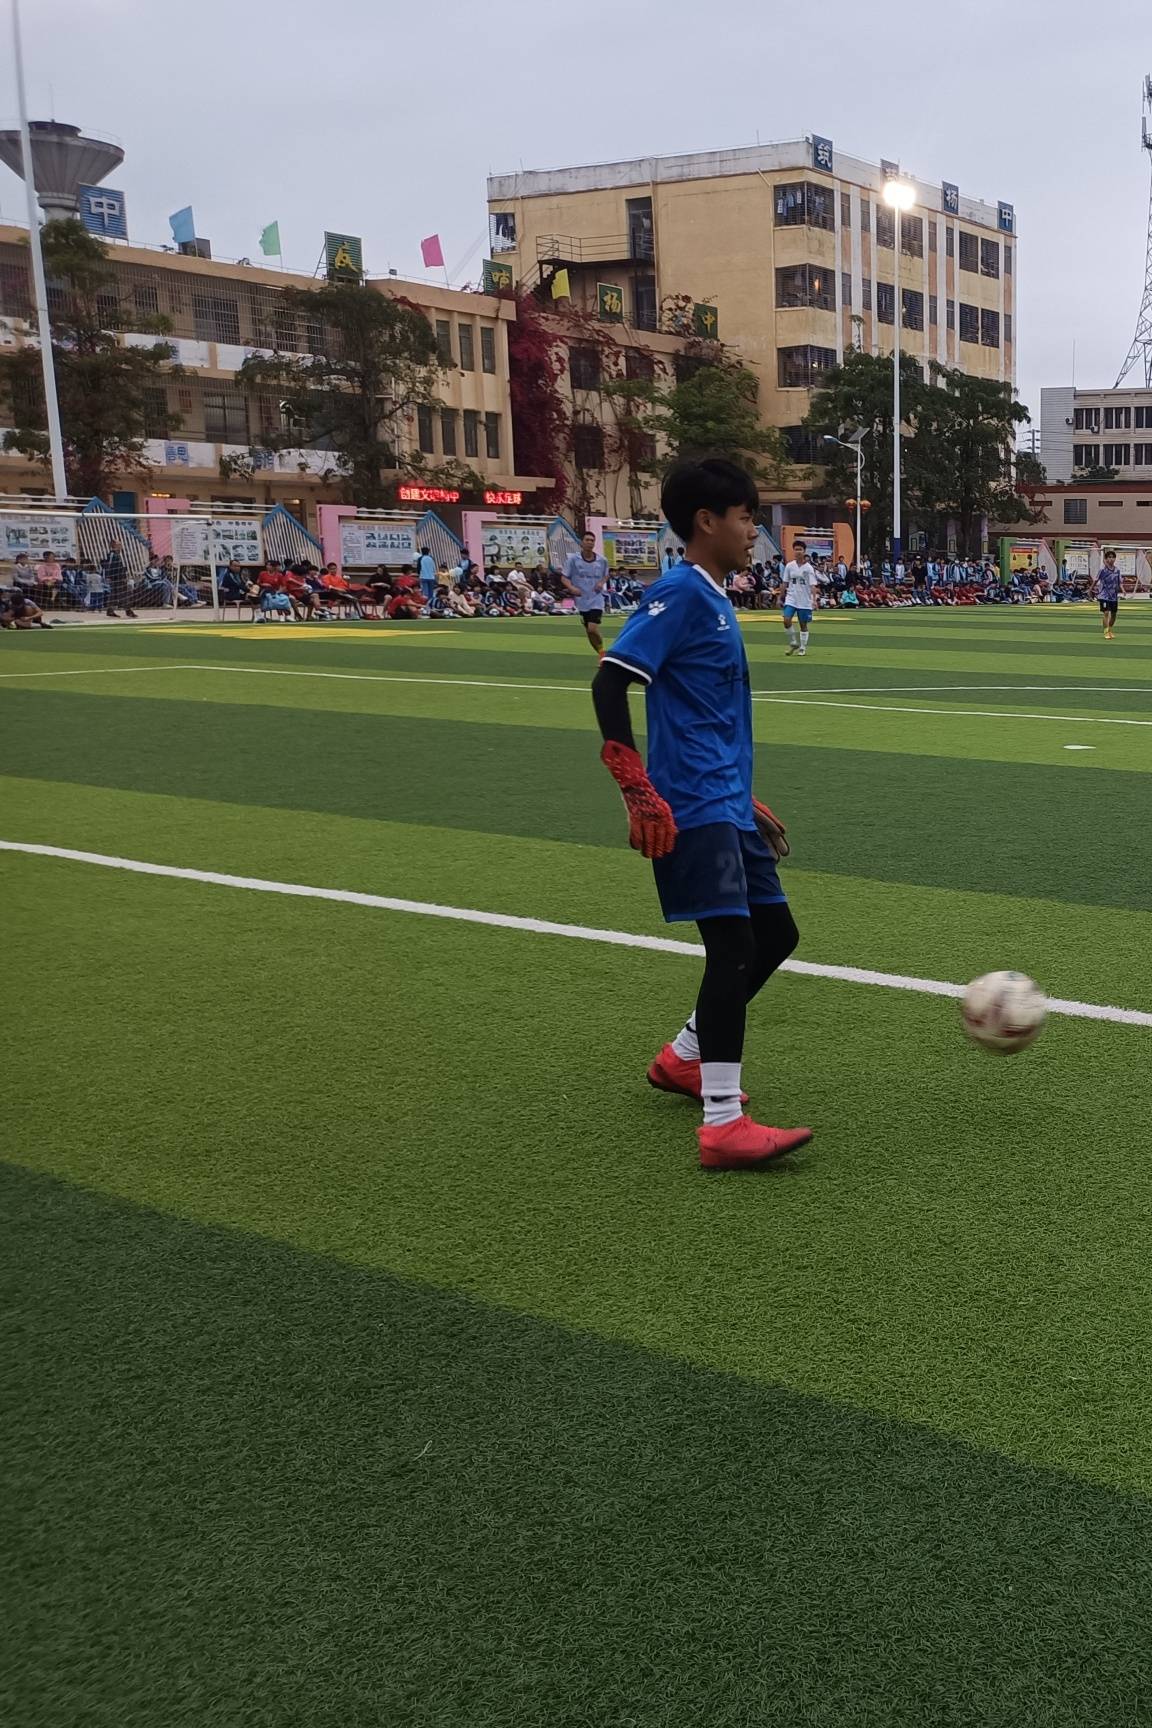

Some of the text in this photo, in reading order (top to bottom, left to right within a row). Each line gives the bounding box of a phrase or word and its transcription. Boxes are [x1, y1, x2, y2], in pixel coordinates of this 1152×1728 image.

[817, 143, 833, 167] 筑
[89, 196, 120, 228] 中
[1000, 208, 1012, 226] 中
[701, 312, 716, 333] 中
